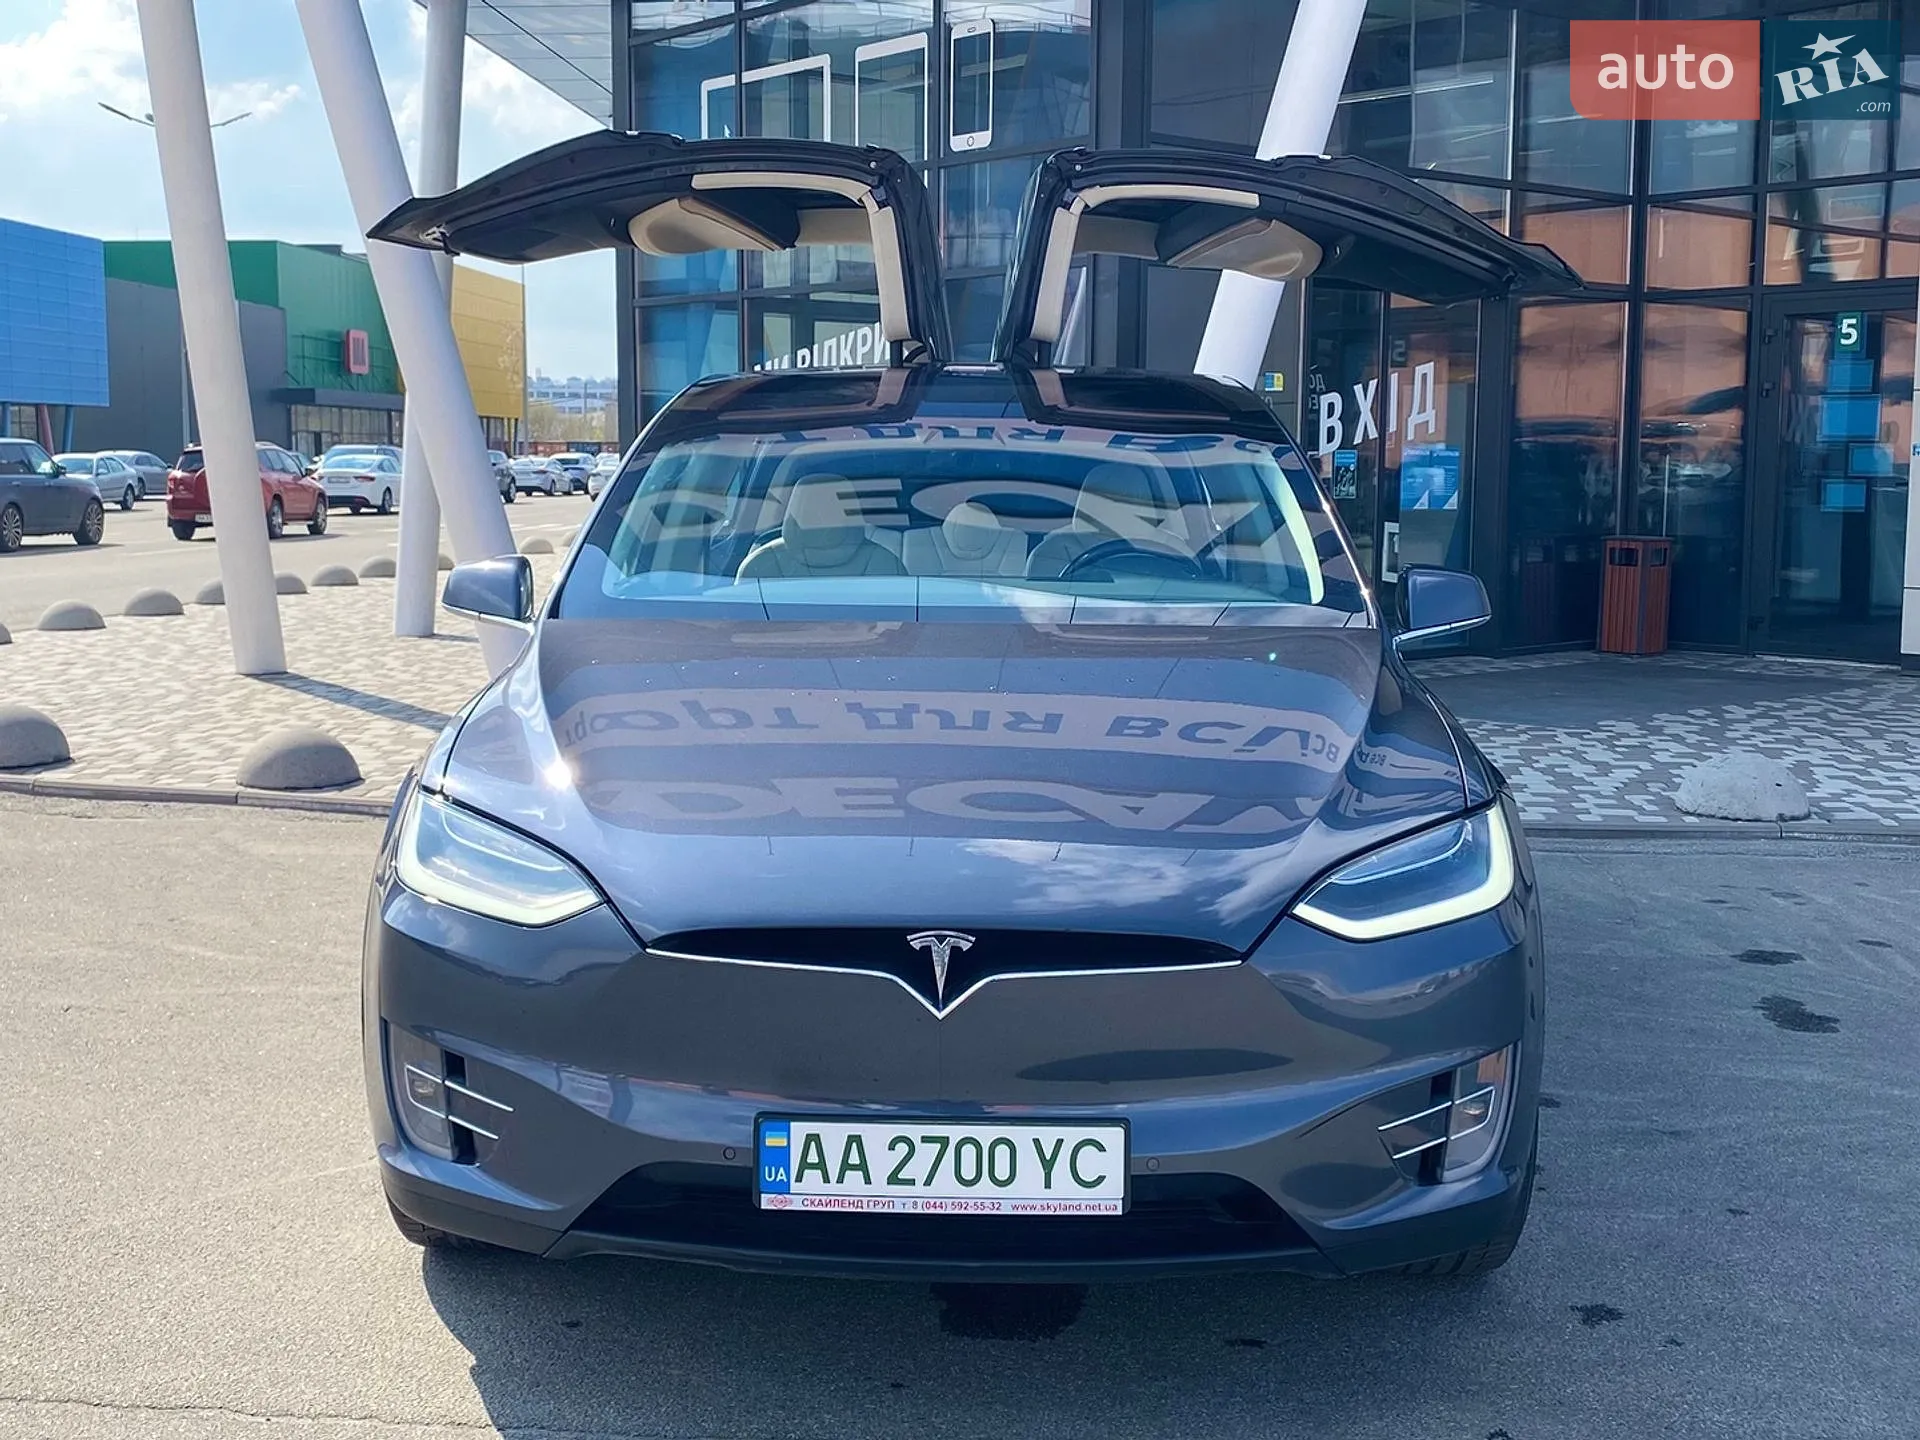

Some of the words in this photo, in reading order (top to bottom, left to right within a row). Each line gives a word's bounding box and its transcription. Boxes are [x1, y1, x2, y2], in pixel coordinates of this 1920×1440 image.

[1840, 318, 1858, 345] 5
[1319, 361, 1436, 456] ВХІД
[765, 1166, 787, 1182] UA
[794, 1133, 872, 1185] AA
[886, 1135, 1017, 1188] 2700
[1032, 1138, 1107, 1190] YC
[801, 1197, 864, 1210] СКАЙЛЕНД
[866, 1199, 895, 1210] ГРУП
[912, 1201, 919, 1210] 8
[921, 1201, 948, 1212] (044)
[951, 1202, 1001, 1211] 592-55-32
[1010, 1202, 1118, 1213] www.skyland.net.ua
